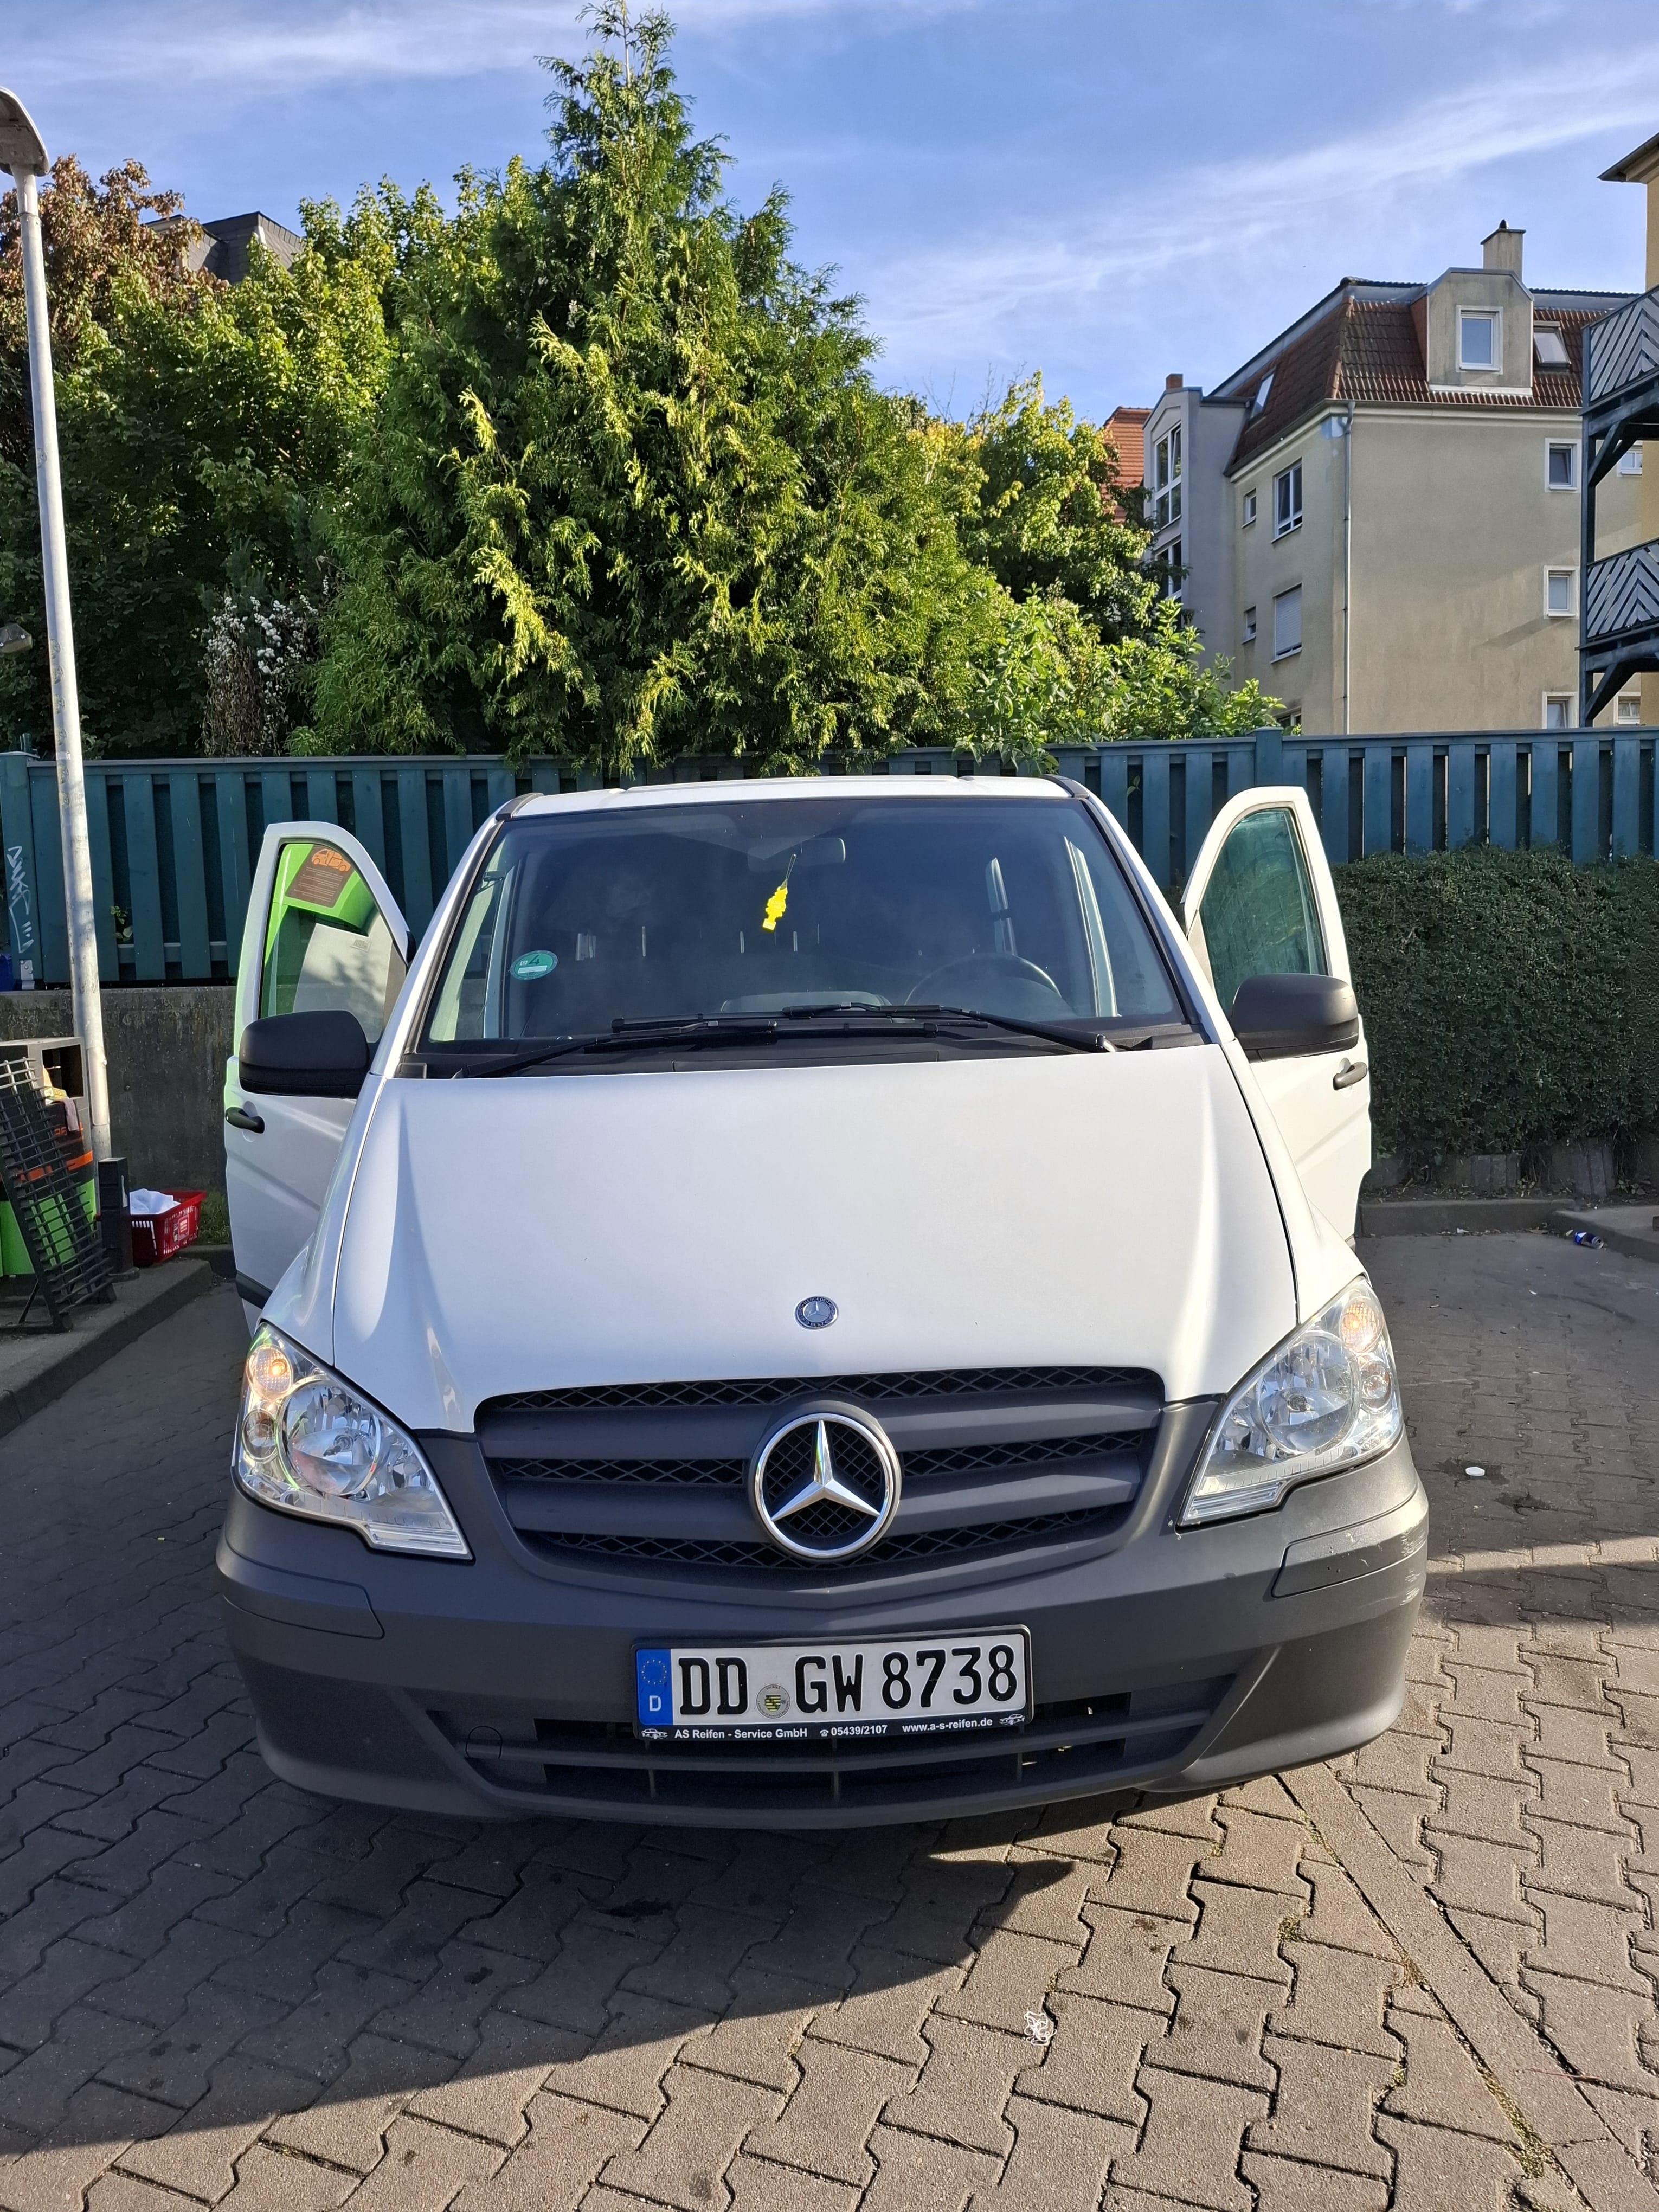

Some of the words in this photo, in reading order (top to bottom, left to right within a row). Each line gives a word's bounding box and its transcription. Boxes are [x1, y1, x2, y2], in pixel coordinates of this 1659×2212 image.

[529, 954, 540, 965] 4
[679, 1657, 748, 1715] DD
[795, 1655, 863, 1712] GW
[882, 1644, 1018, 1709] 8738
[649, 1696, 662, 1711] D
[674, 1729, 689, 1738] AS
[692, 1729, 725, 1738] Reifen
[734, 1728, 773, 1738] Service
[775, 1728, 807, 1738] GmbH
[831, 1725, 888, 1736] 05439/2107
[902, 1718, 993, 1733] www.a-s-reifen.de
